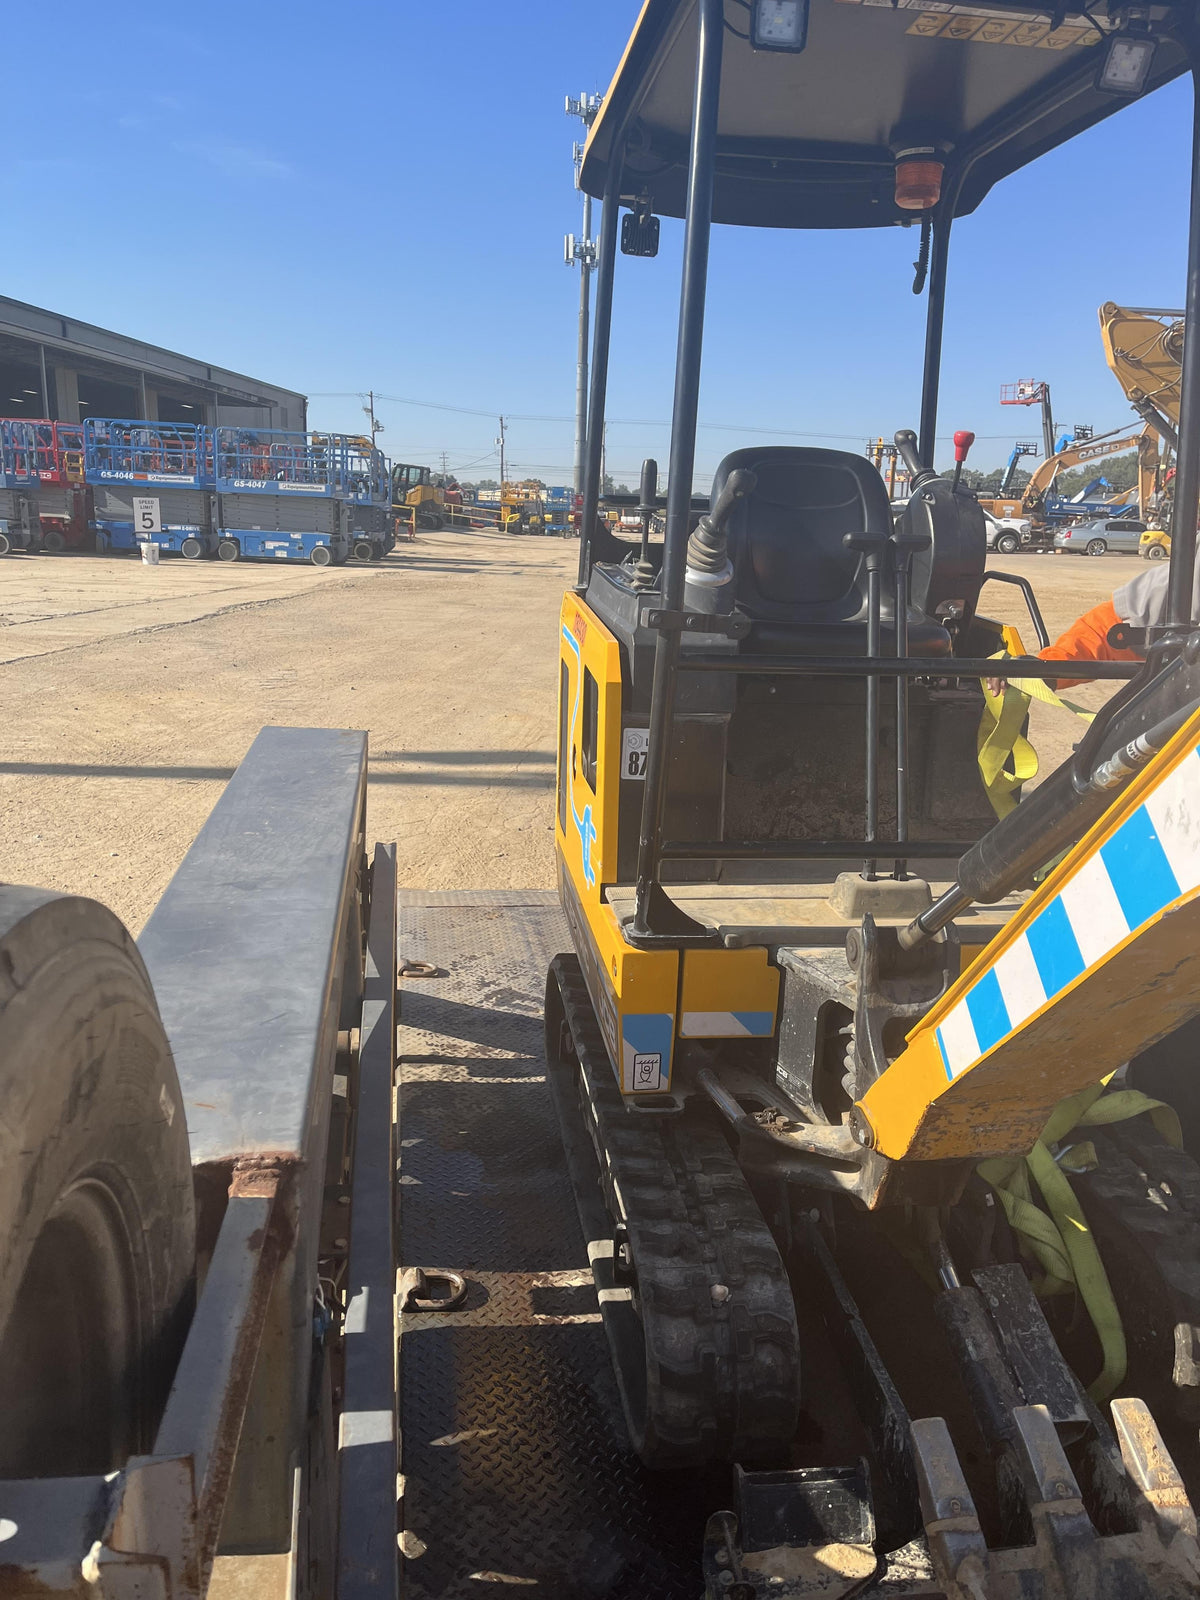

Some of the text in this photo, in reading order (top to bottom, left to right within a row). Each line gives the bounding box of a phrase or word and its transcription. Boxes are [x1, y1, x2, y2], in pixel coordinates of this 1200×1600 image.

[1078, 445, 1110, 459] CASE
[100, 471, 134, 480] GS-4046
[233, 480, 267, 489] GS-4047
[142, 512, 154, 529] 5
[628, 751, 648, 776] 87
